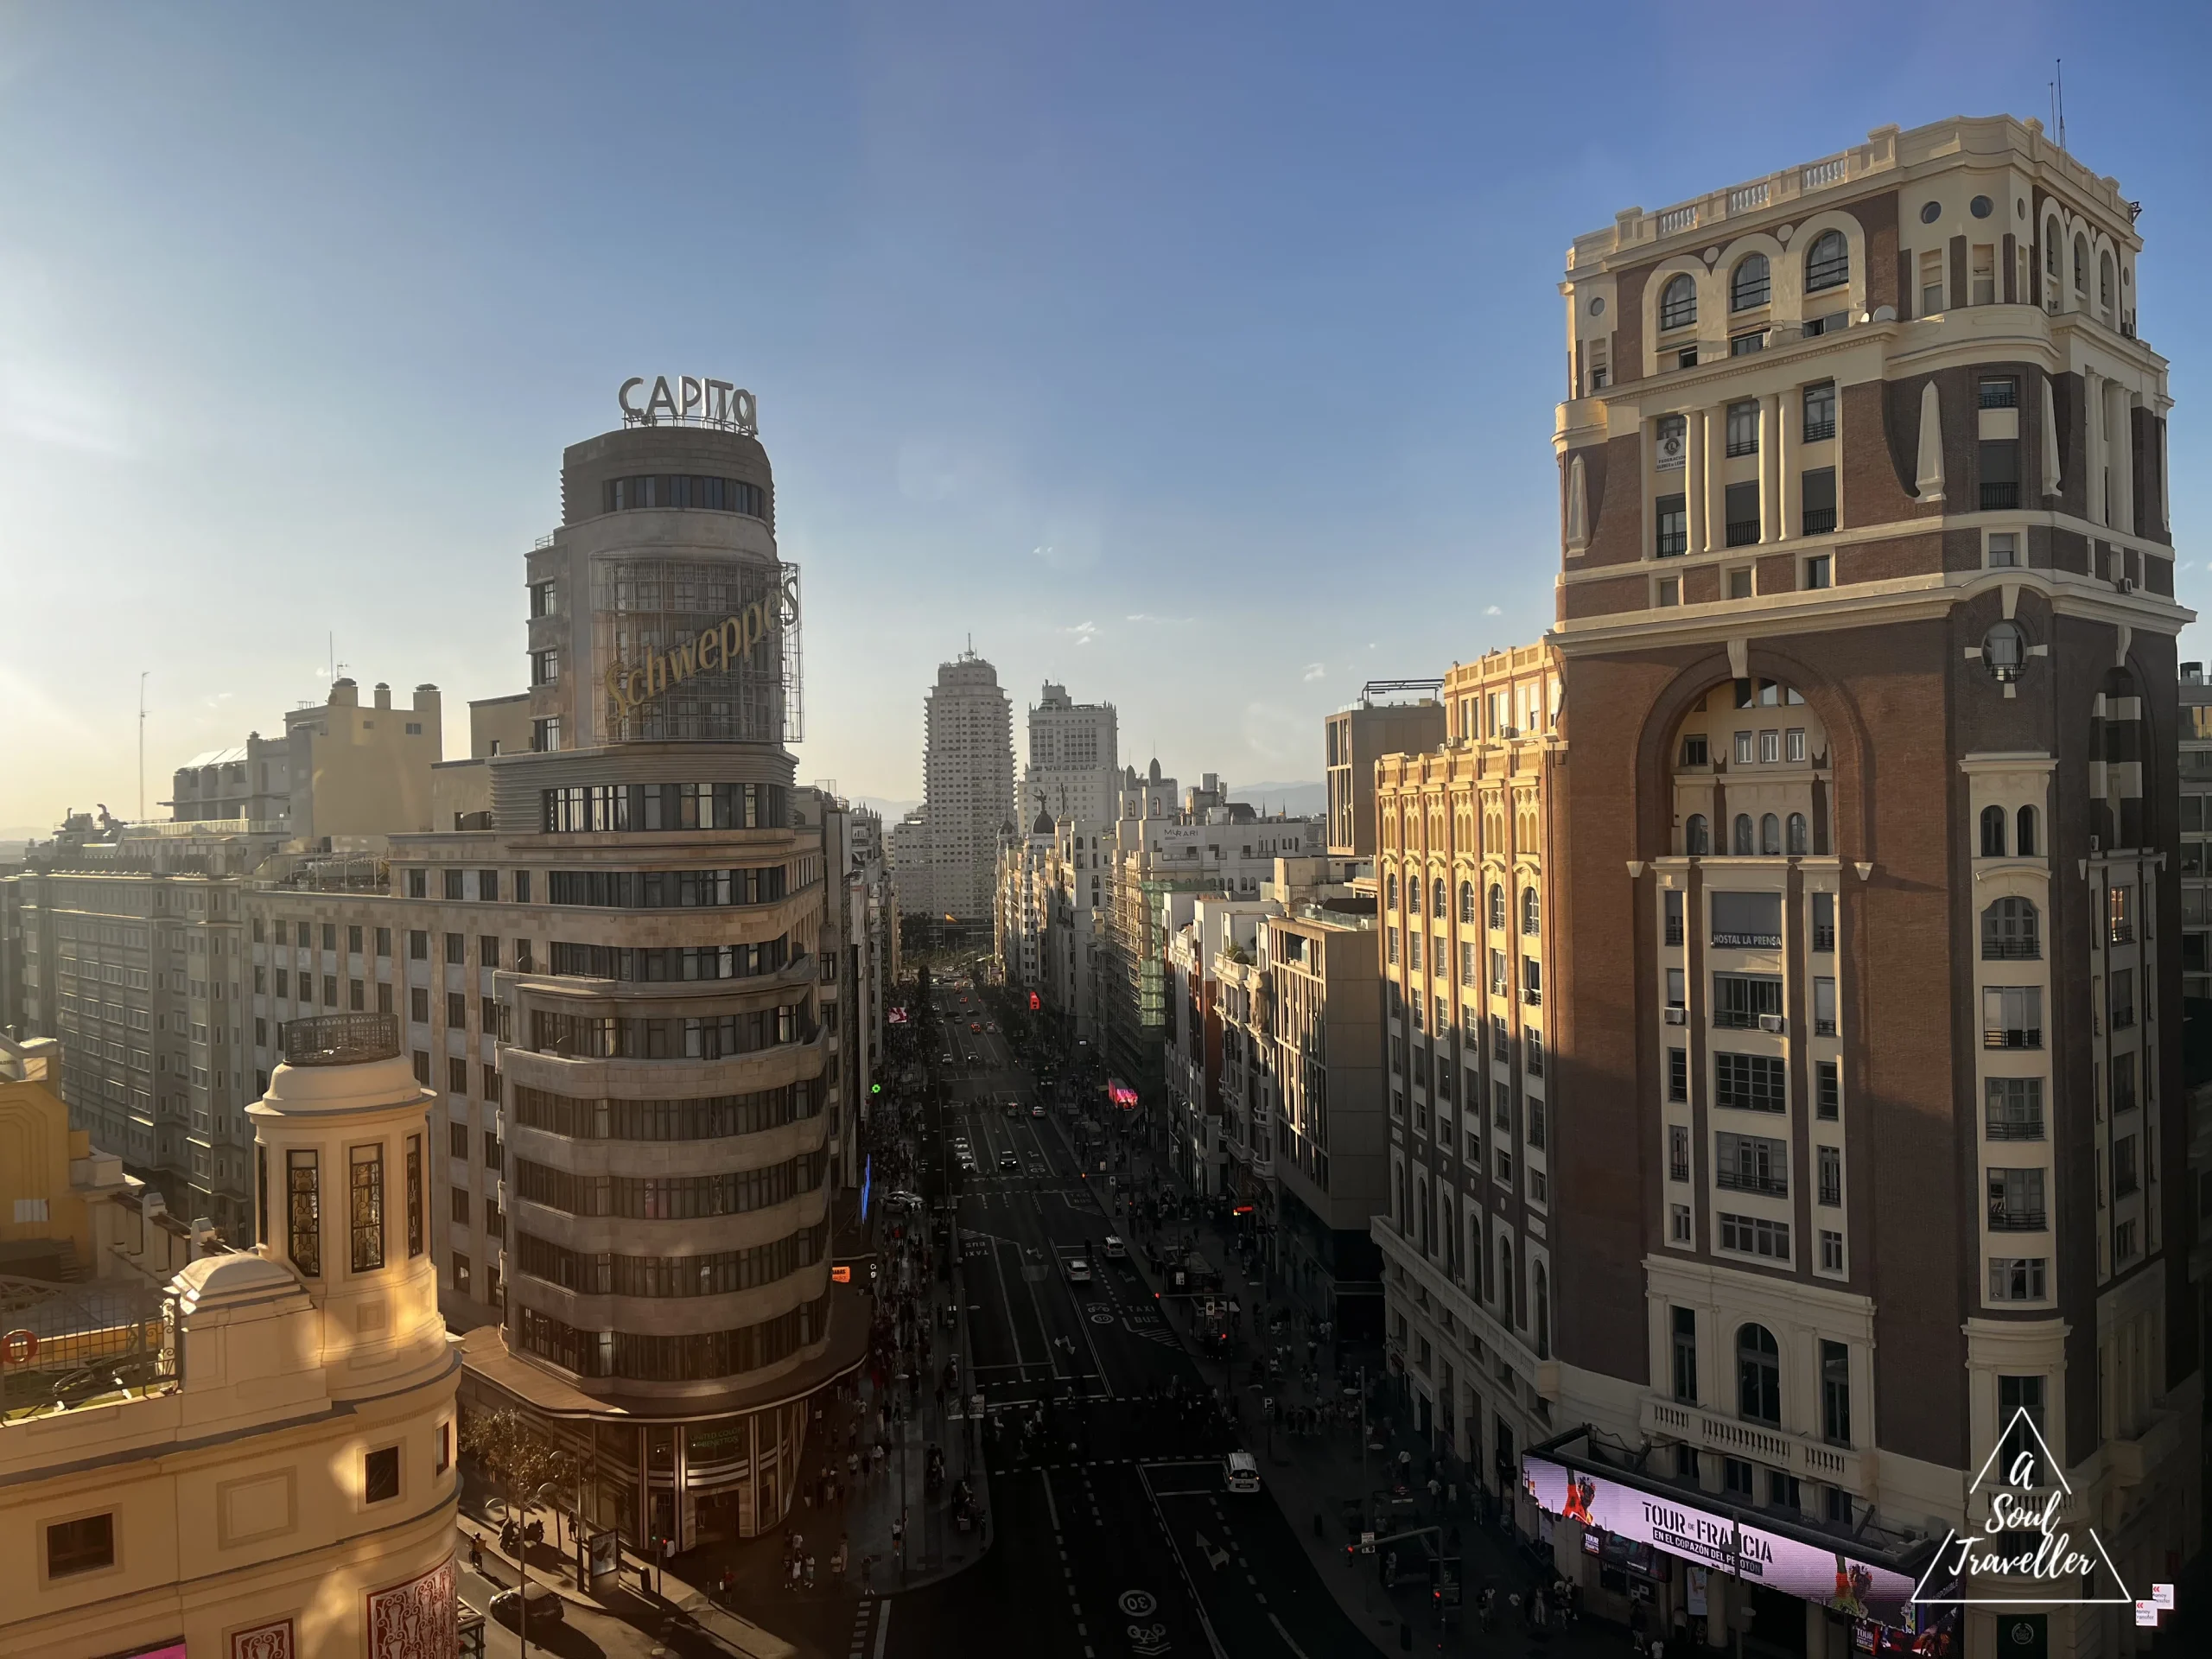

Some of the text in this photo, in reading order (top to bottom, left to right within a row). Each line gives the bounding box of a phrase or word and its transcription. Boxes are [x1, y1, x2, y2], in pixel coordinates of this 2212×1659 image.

[605, 576, 799, 727] Schweppes
[1713, 934, 1782, 945] HOSTAL LA PRENSA
[1134, 1315, 1160, 1324] BUS
[1642, 1501, 1686, 1535] TOUR
[1696, 1518, 1773, 1564] FRACIA
[1654, 1529, 1664, 1541] EN
[1665, 1534, 1675, 1545] EL
[1675, 1536, 1710, 1557] CORAZÓN
[1711, 1548, 1726, 1562] DEL
[1726, 1554, 1762, 1573] PEOTÓN
